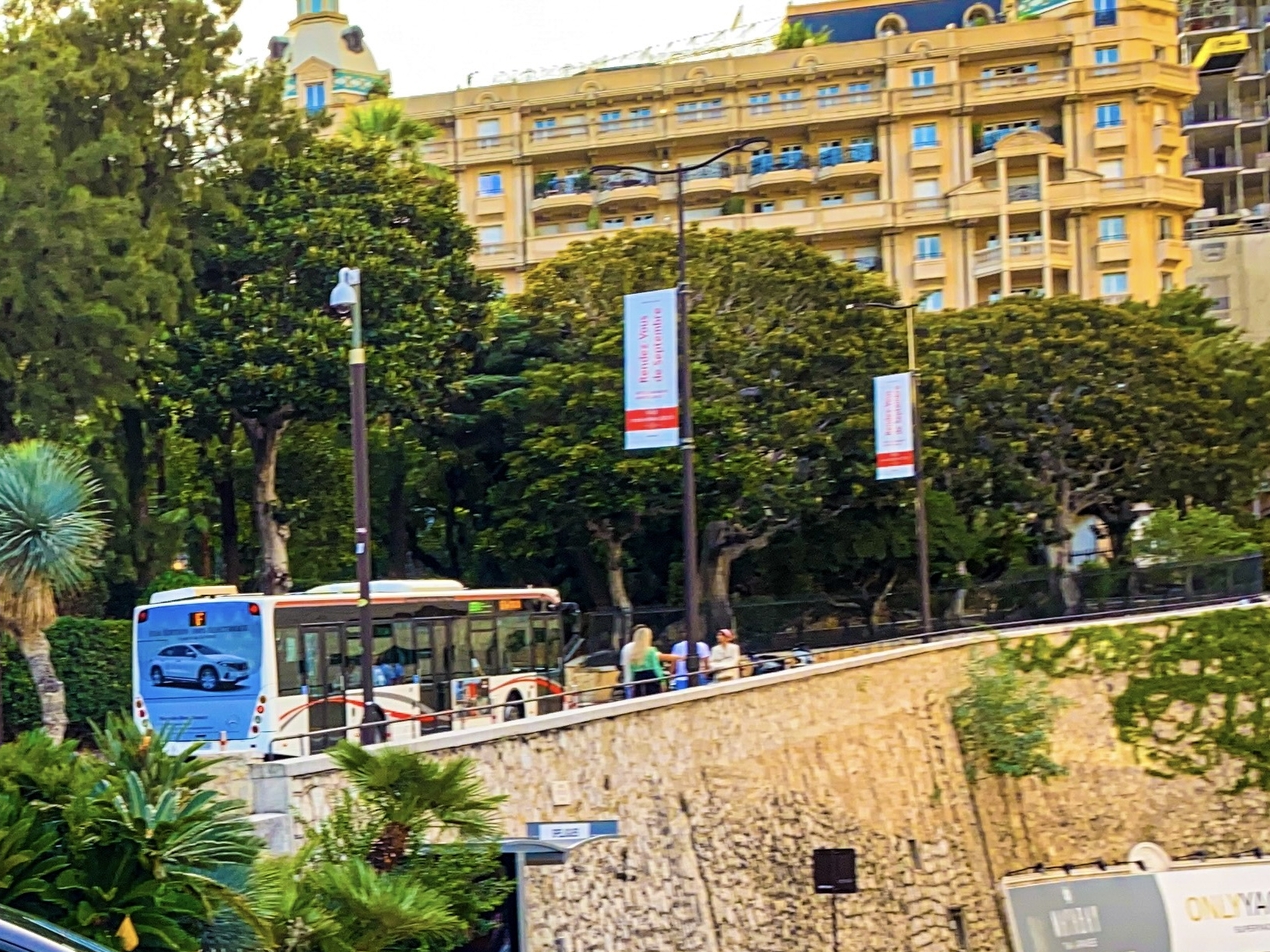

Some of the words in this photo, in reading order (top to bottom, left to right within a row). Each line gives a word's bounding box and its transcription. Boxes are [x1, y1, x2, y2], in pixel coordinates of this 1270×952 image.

[638, 315, 649, 340] Vous
[652, 307, 664, 366] Septembre
[638, 344, 649, 383] Rendez
[652, 369, 662, 382] de
[194, 611, 205, 626] F
